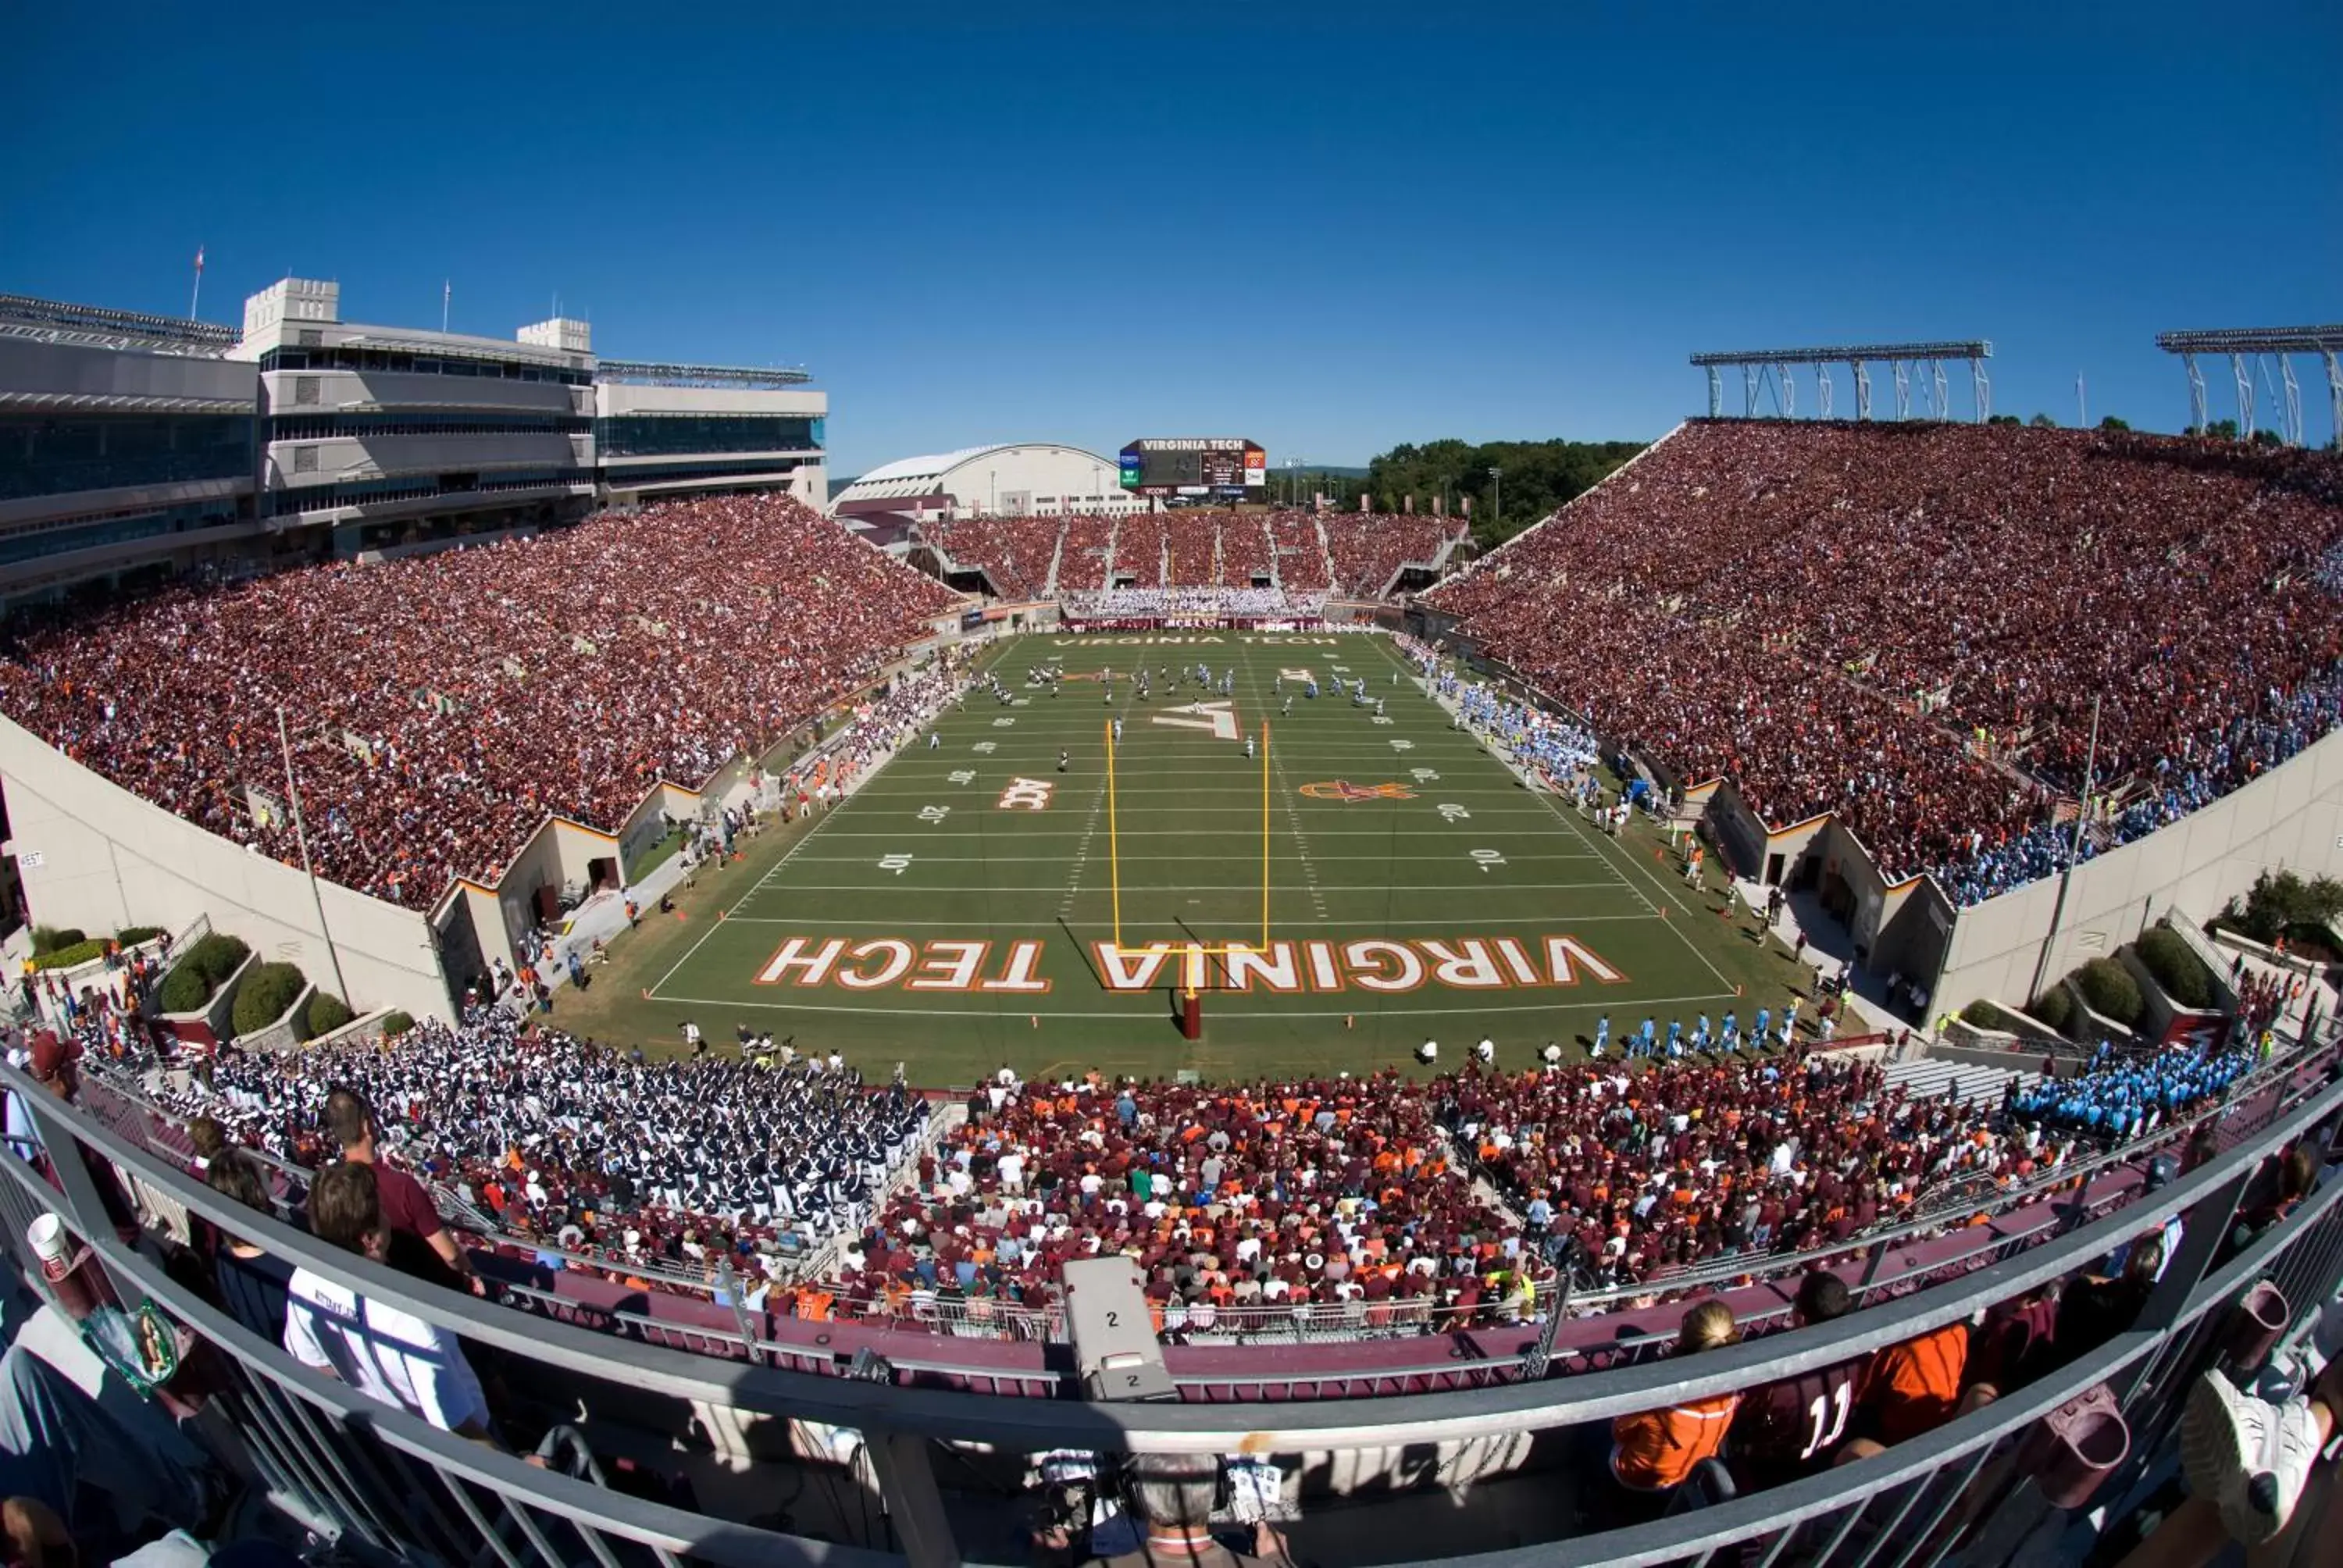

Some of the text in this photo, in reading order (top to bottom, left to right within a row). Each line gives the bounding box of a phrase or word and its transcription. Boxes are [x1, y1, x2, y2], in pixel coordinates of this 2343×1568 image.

[1143, 440, 1243, 451] VIRGINIA TECH
[1054, 636, 1225, 646] VIRGINIA
[917, 805, 950, 819] 20
[1436, 804, 1471, 818] 20
[878, 853, 913, 869] 10
[1469, 848, 1507, 864] 10
[753, 935, 1629, 992] VIRGINIA TECH
[1106, 1311, 1119, 1327] 2
[1126, 1374, 1141, 1387] 2
[1800, 1379, 1852, 1460] 11
